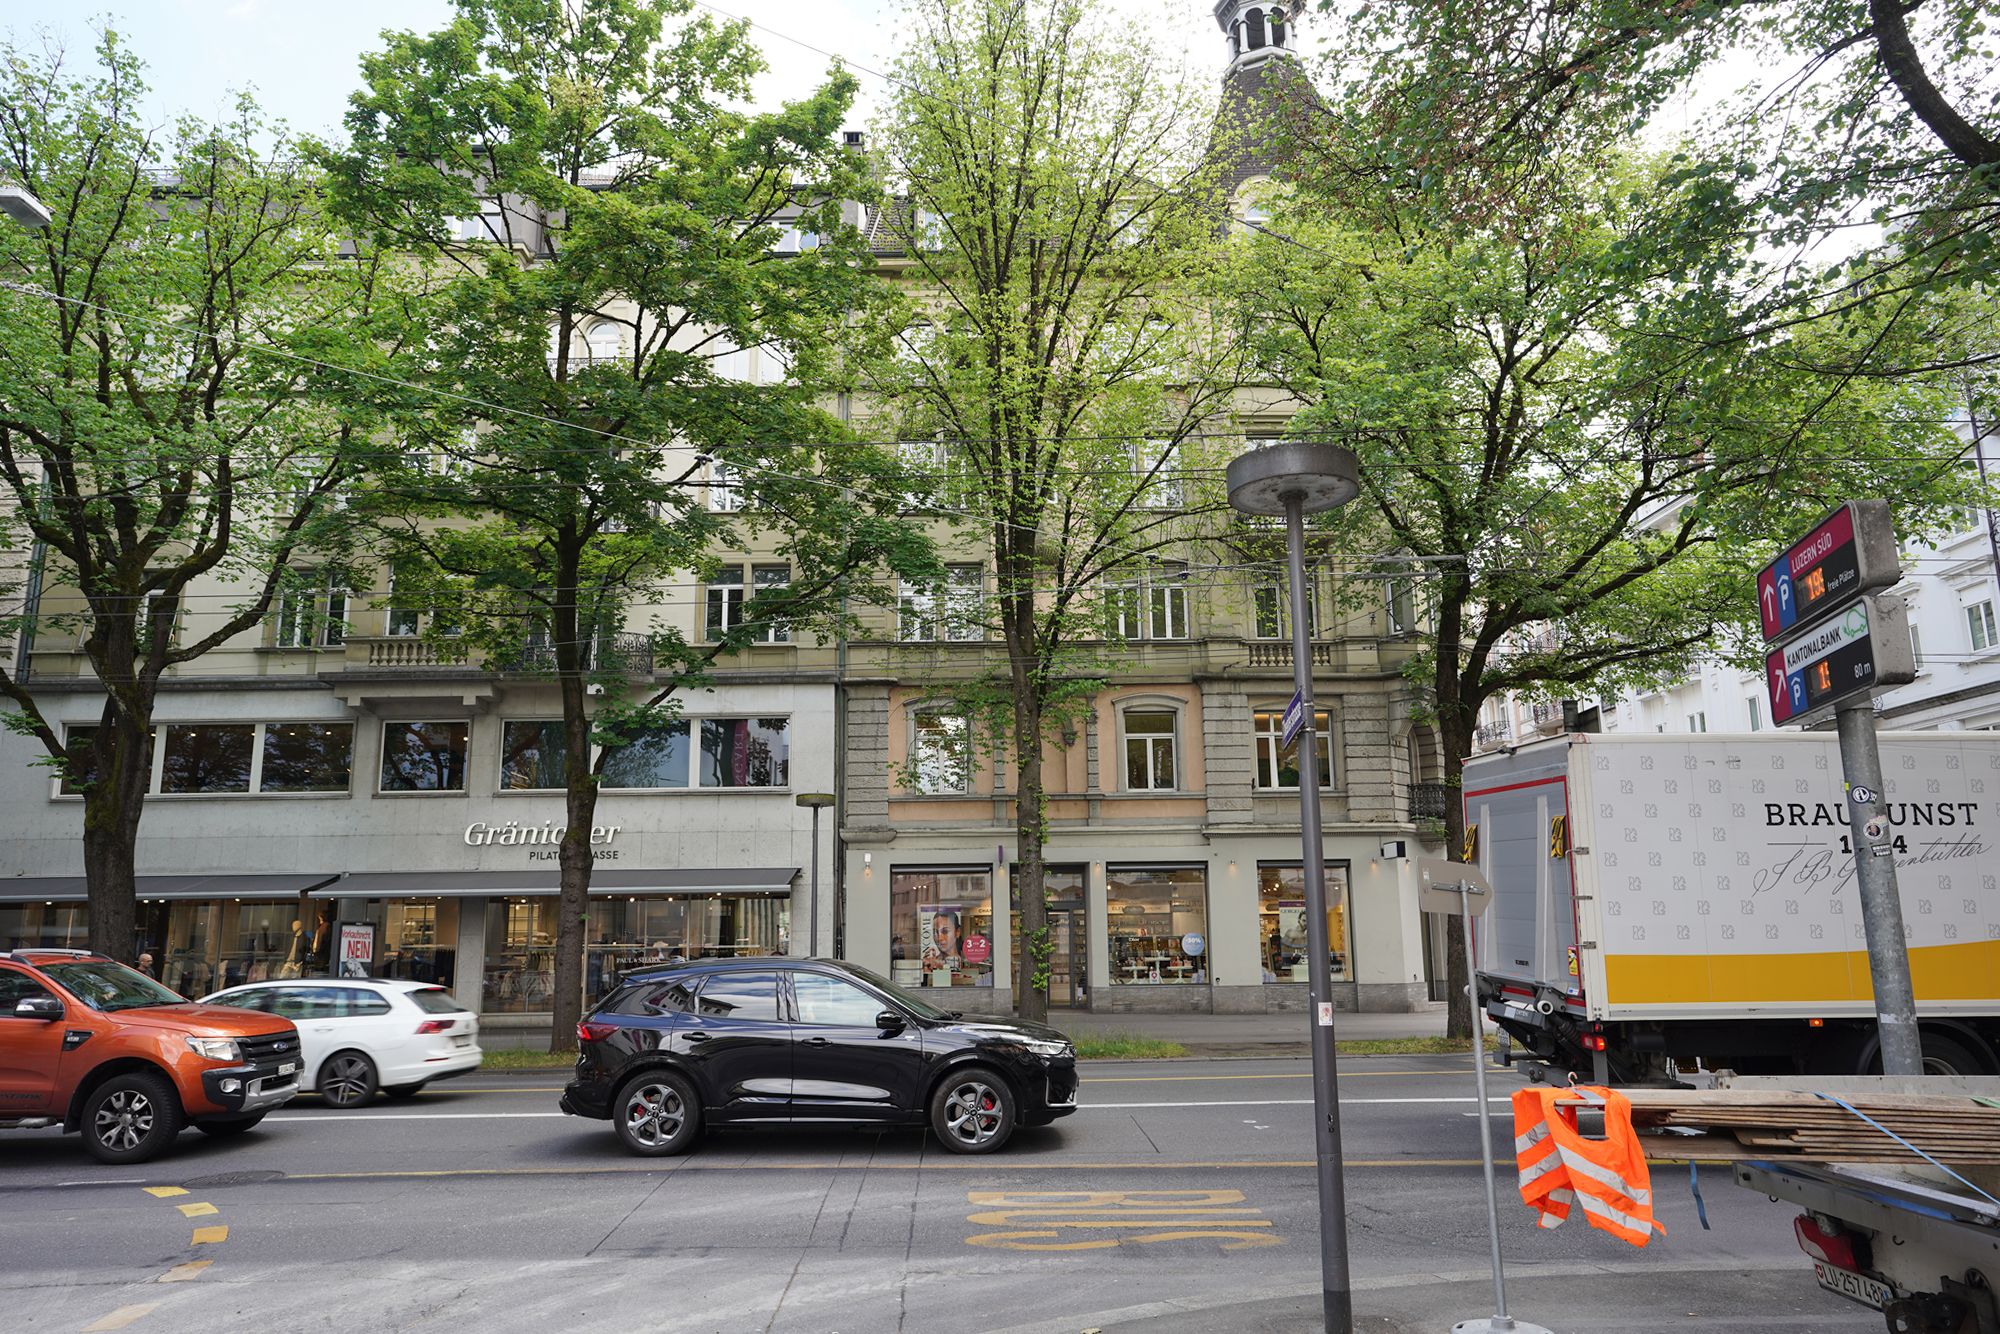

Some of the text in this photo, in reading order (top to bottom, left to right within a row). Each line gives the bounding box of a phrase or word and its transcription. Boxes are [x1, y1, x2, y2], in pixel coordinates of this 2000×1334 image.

[1791, 532, 1832, 573] LUZERN SÜD
[1786, 626, 1842, 668] KANTONALBANK
[1854, 662, 1871, 679] 80 m
[1765, 803, 1978, 826] BRAUUNST
[464, 821, 621, 846] Gränicer
[1839, 834, 1908, 855] 14
[529, 851, 619, 860] PILATASSE
[346, 940, 370, 959] NEIN
[966, 939, 972, 949] 3
[980, 939, 986, 948] 2
[1822, 1265, 1839, 1288] LU
[1840, 1272, 1861, 1297] 257
